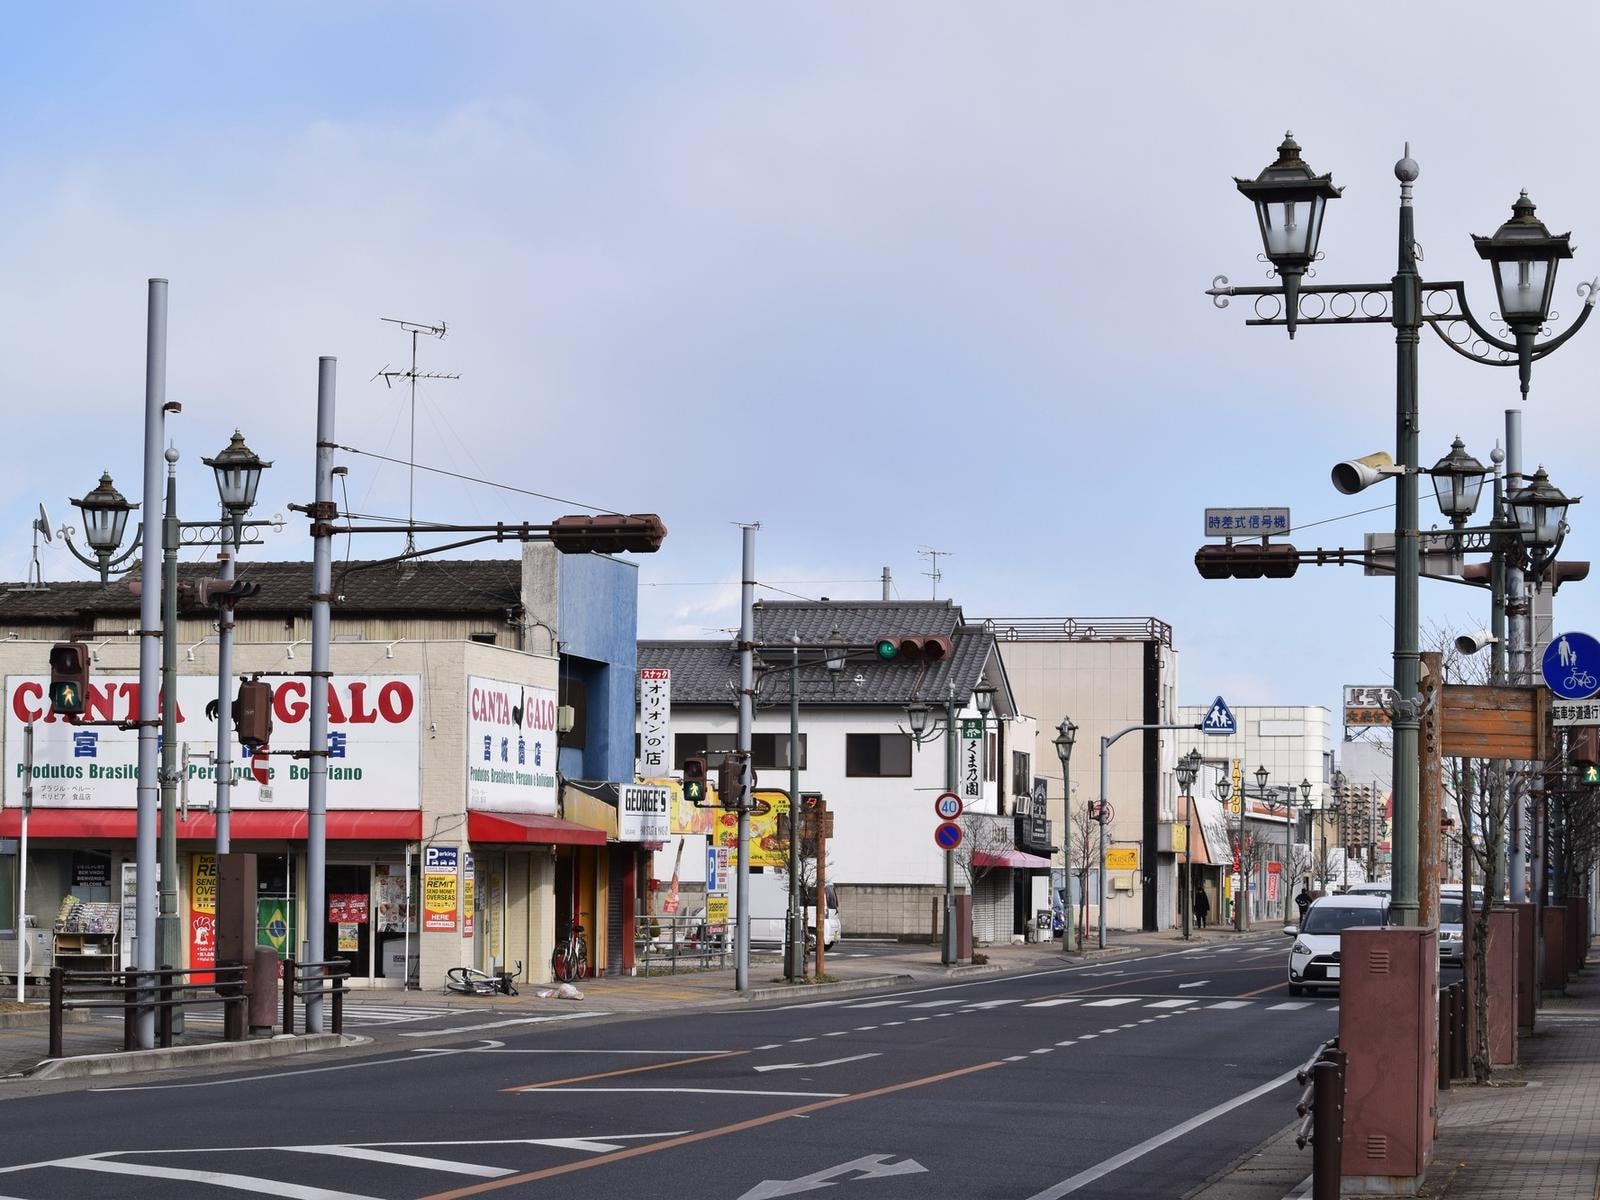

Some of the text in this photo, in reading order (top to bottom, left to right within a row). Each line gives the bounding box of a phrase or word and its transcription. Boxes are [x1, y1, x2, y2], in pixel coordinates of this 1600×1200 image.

[1208, 515, 1286, 529] 時差式信号機
[643, 670, 668, 679] スナック
[472, 688, 555, 732] CANTA GALO
[645, 684, 662, 766] オリオンの店
[965, 740, 979, 797] くま乃園
[625, 788, 667, 813] GEORGE'S
[941, 800, 957, 813] 40
[426, 848, 457, 866] Parking
